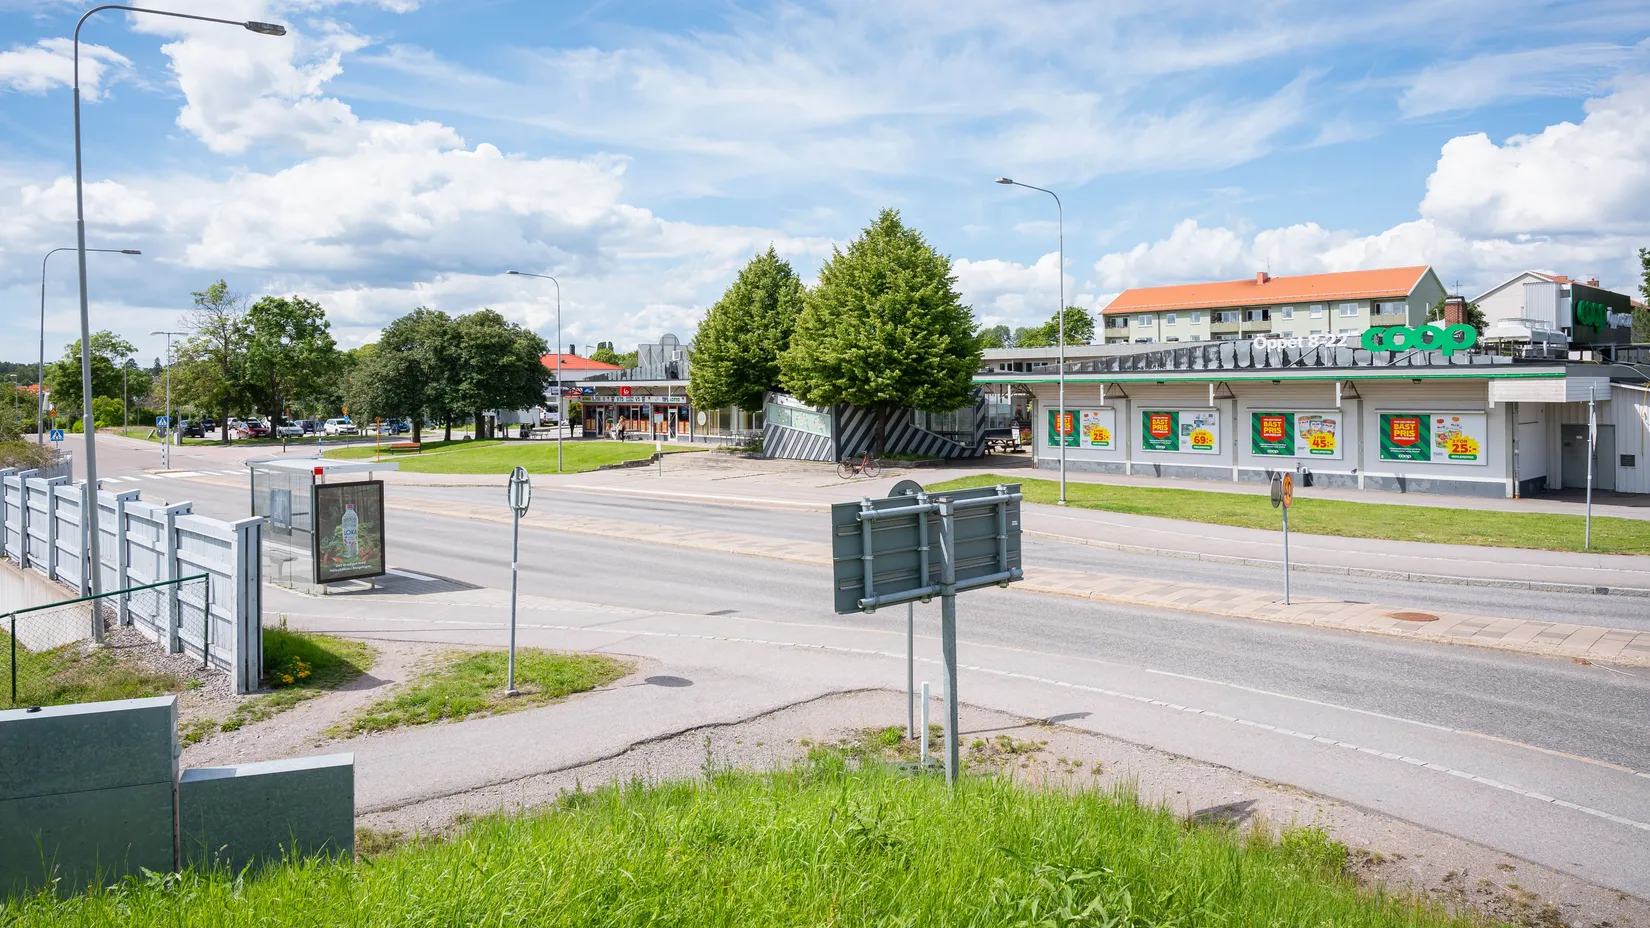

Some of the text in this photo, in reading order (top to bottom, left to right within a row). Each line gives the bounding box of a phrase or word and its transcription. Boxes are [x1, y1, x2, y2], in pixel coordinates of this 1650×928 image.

[1253, 333, 1347, 353] Öppet 8-22
[1361, 323, 1478, 357] coop
[1452, 443, 1477, 453] 25:-
